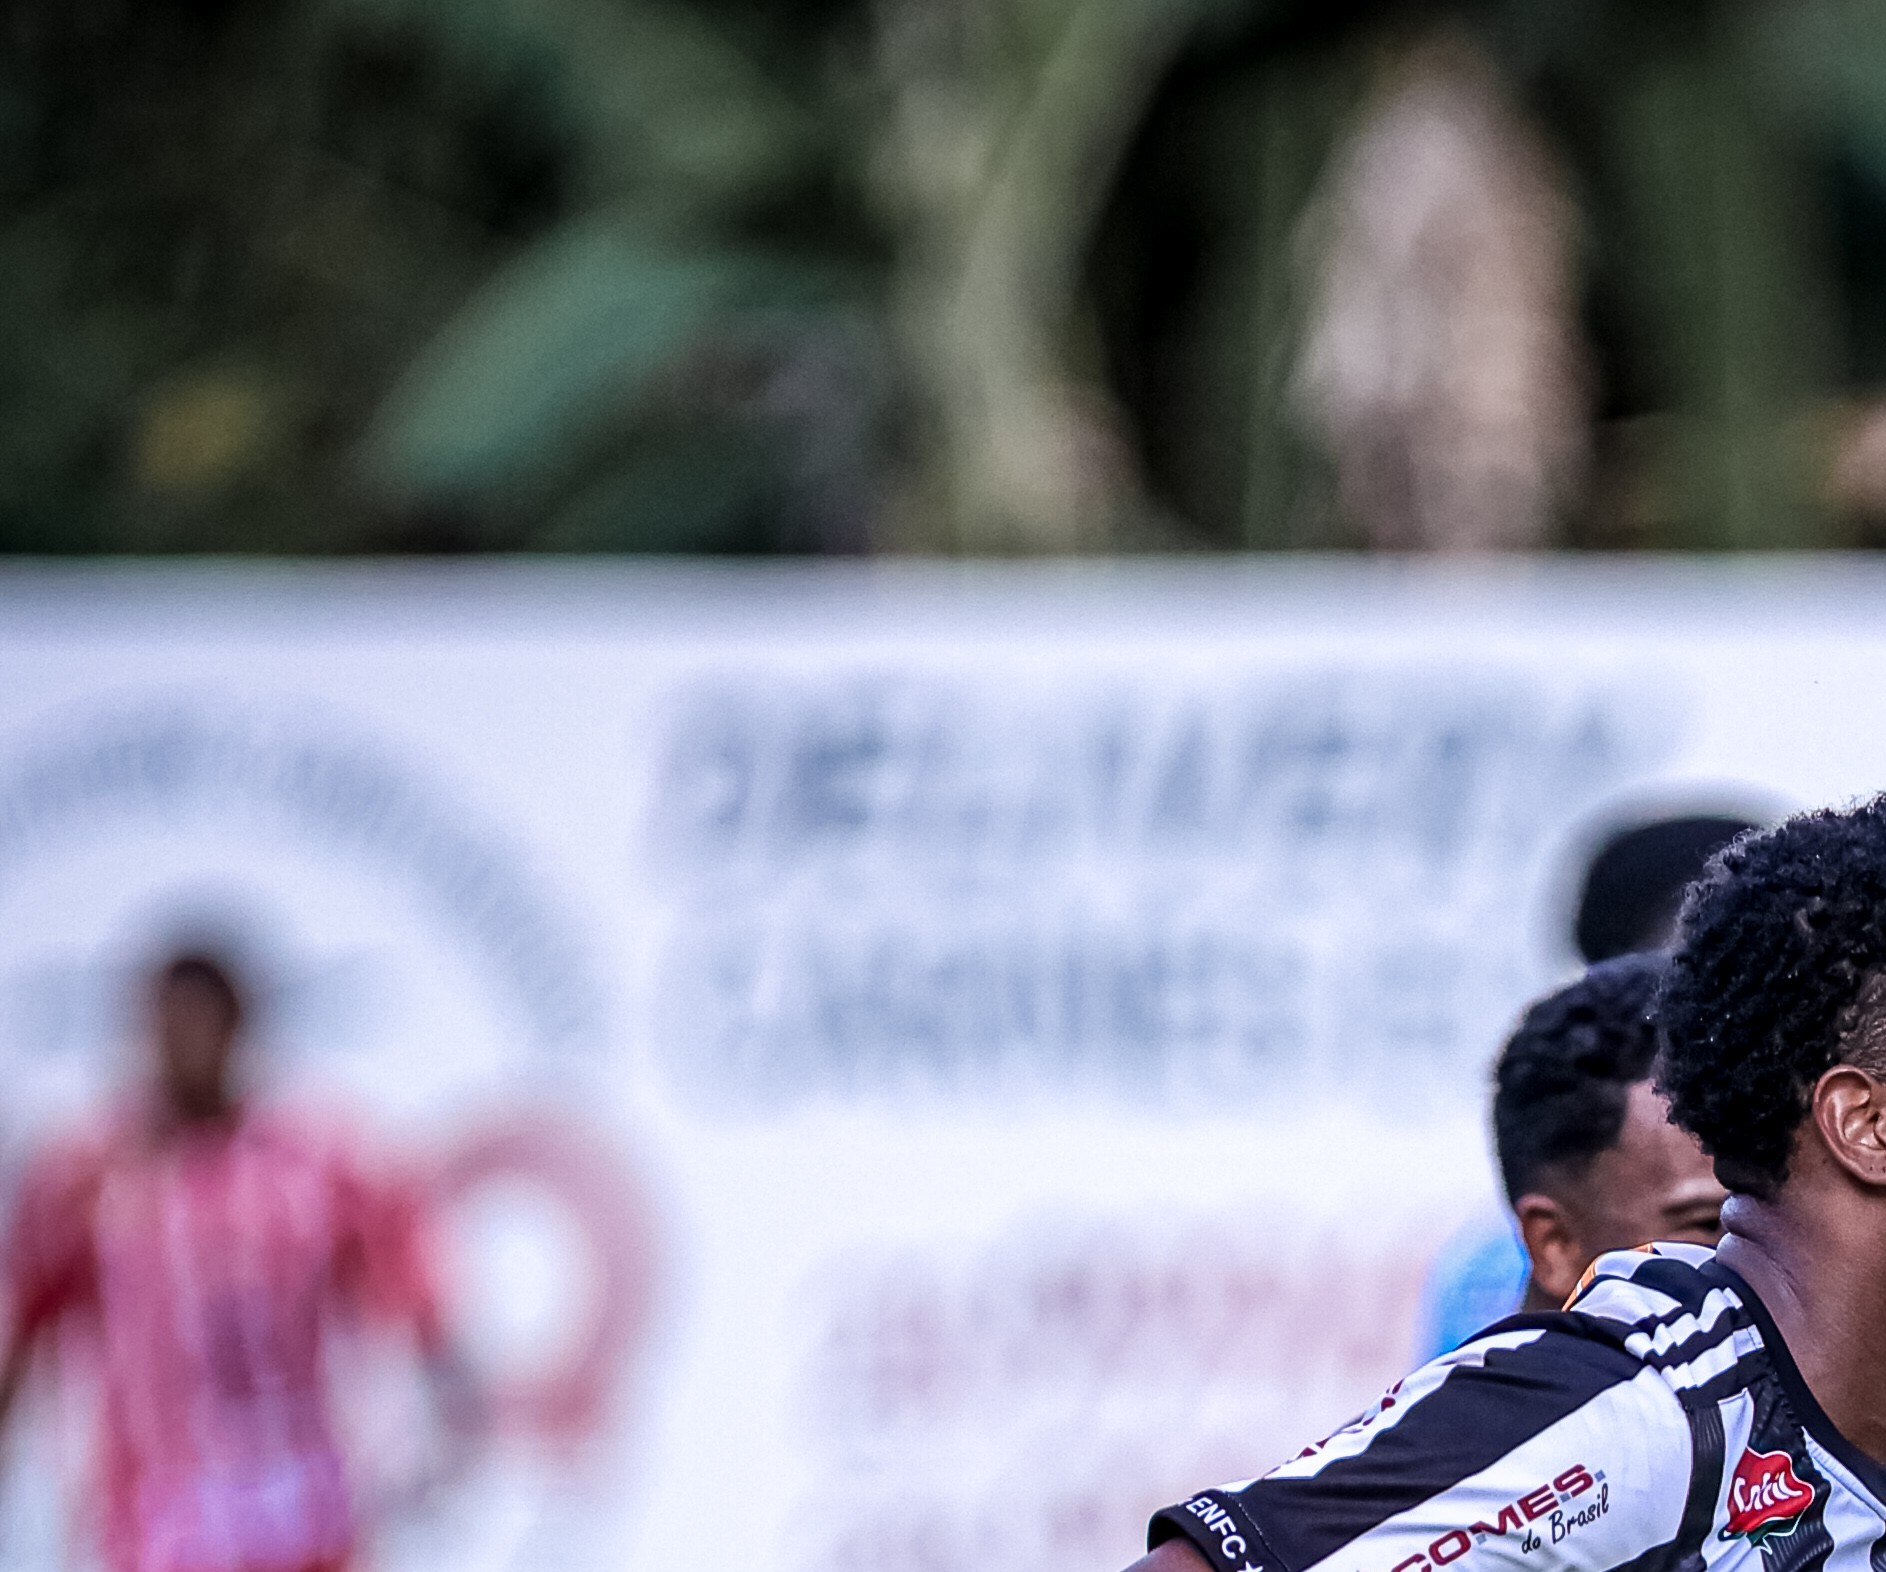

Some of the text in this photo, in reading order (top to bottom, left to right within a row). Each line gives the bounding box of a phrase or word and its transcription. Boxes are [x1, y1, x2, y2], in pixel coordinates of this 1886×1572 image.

[1185, 1497, 1246, 1560] ENFC
[1521, 1483, 1609, 1554] do Brasil
